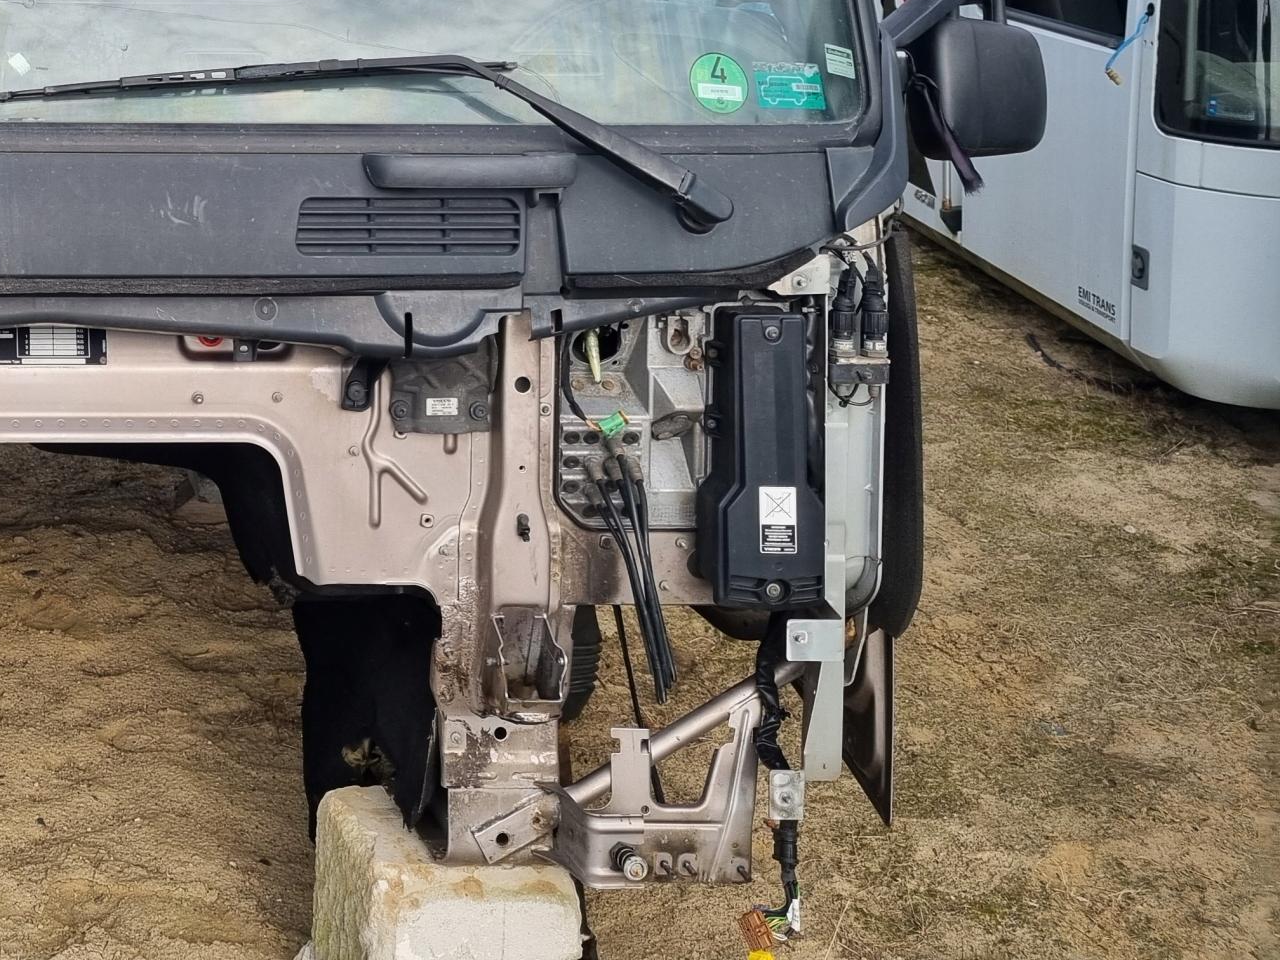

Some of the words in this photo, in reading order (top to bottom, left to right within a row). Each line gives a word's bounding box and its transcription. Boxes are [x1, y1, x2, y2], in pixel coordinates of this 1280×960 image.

[710, 56, 727, 83] 4
[1078, 285, 1092, 302] EMI
[1092, 292, 1116, 317] TRANS
